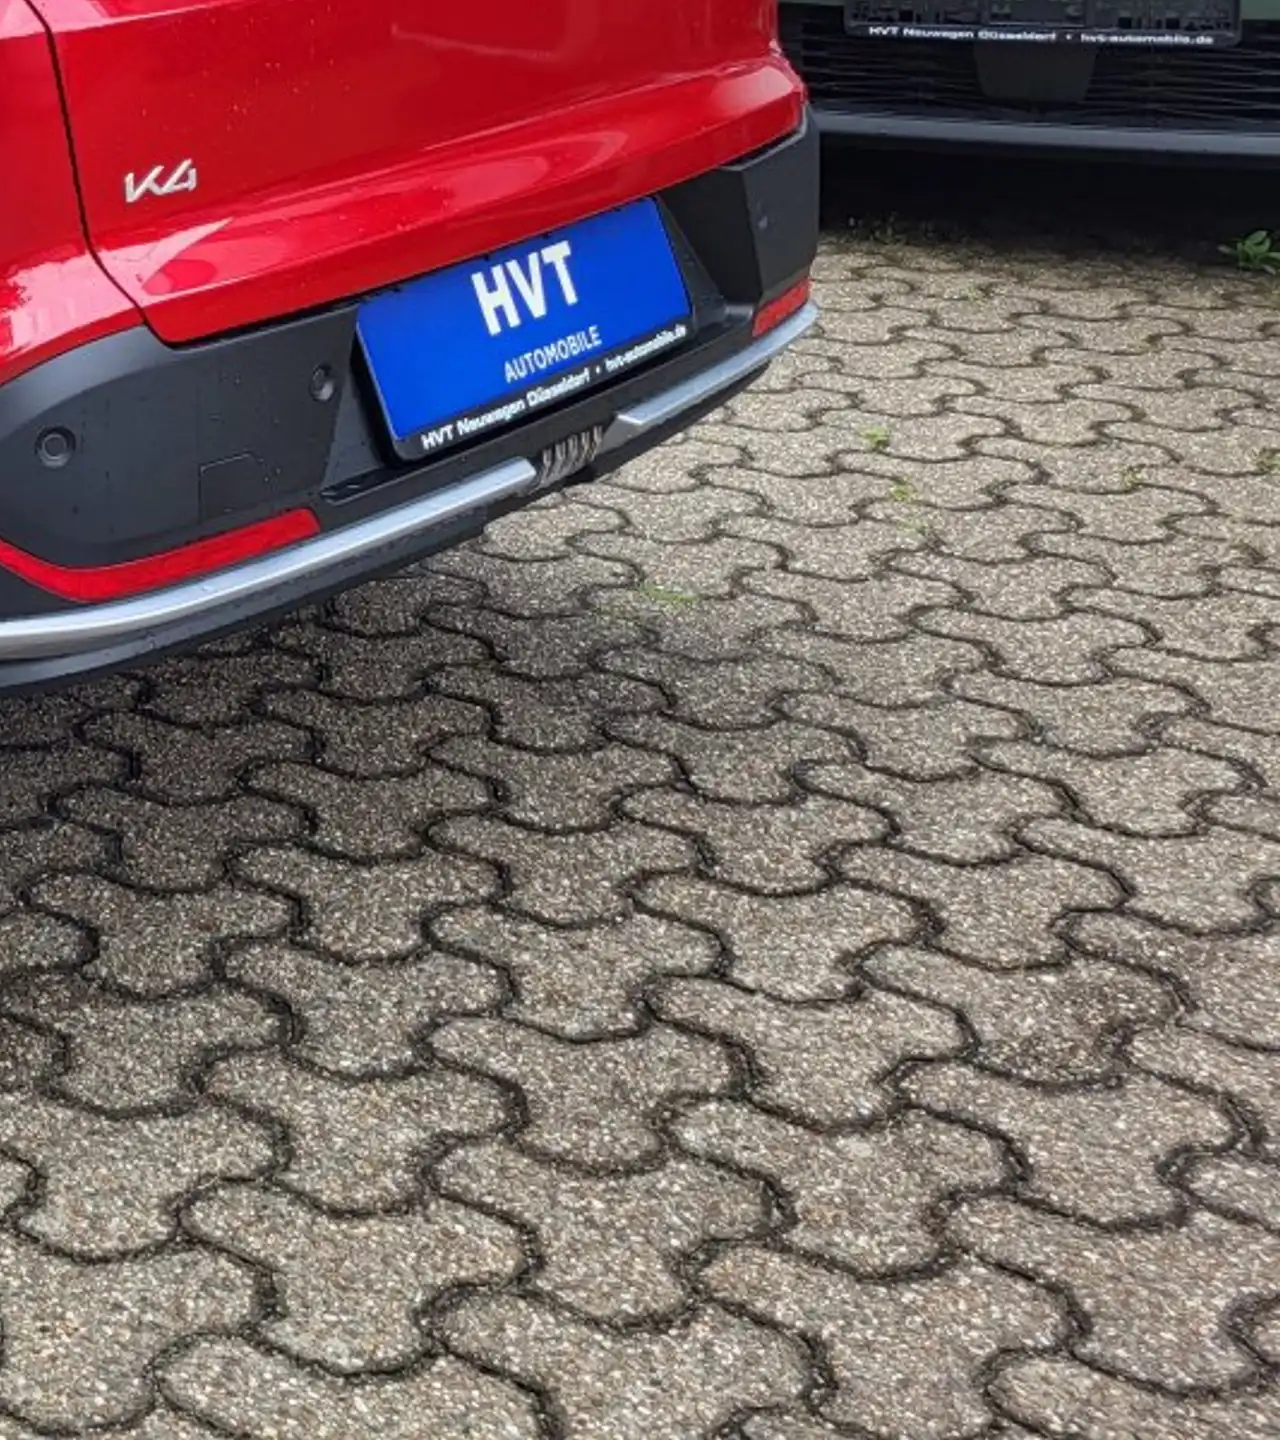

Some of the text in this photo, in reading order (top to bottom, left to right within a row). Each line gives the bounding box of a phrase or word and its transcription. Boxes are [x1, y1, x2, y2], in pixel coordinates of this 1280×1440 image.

[869, 26, 898, 36] HVT
[903, 27, 974, 39] Neuwagen
[124, 158, 197, 203] K4
[470, 240, 579, 336] HVT
[503, 325, 603, 383] AUTOMOBILE
[420, 423, 454, 451] HVT
[456, 397, 526, 436] Neuwagen
